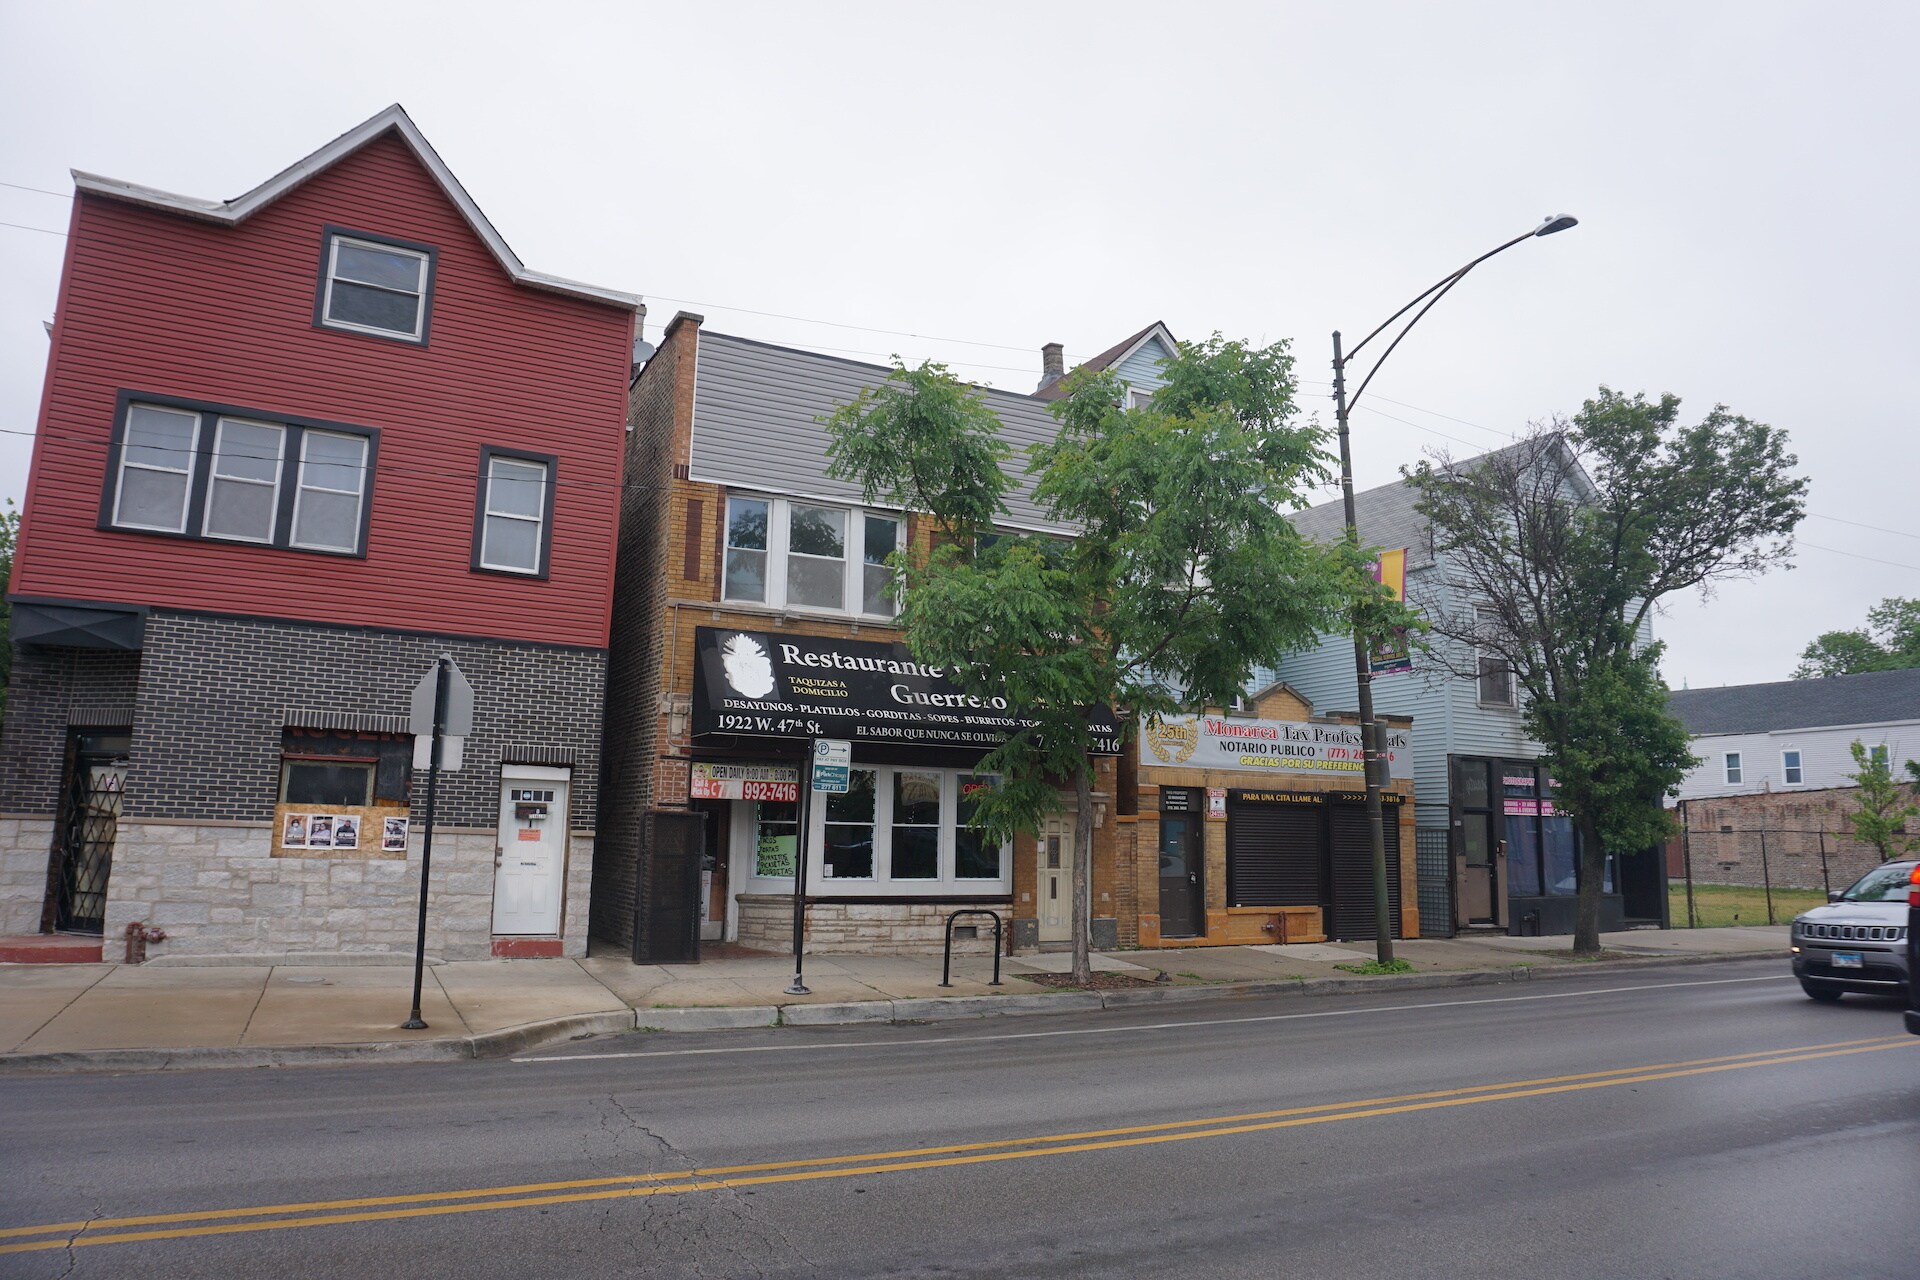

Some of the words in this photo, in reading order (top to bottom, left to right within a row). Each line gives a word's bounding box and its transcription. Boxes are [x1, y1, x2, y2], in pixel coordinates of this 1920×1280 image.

[779, 643, 943, 678] Restaurante
[788, 676, 838, 688] TAQUIZAS
[840, 680, 847, 688] A
[792, 686, 849, 698] DOMICILIO
[723, 699, 793, 712] DESAYUNOS
[800, 704, 860, 717] PLATILLOS
[866, 709, 921, 721] GORDITAS
[927, 713, 959, 724] SOPES
[964, 715, 1015, 727] BURRITOS
[718, 714, 753, 730] 1922
[755, 717, 775, 732] W.
[806, 720, 824, 735] St.
[1158, 723, 1188, 740] 25th
[1204, 719, 1279, 741] Monarca
[1281, 724, 1310, 743] Tax
[856, 725, 869, 736] EL
[870, 726, 903, 738] SABOR
[903, 728, 925, 740] QUE
[926, 729, 960, 741] NUNCA
[960, 731, 973, 743] SE
[1219, 740, 1268, 755] NOTARIO
[1271, 744, 1316, 757] PUBLICO
[1327, 747, 1349, 761] (773)
[1239, 756, 1280, 768] GRACIAS
[1281, 757, 1301, 769] POR
[1303, 759, 1315, 770] SU
[1316, 760, 1365, 772] PREFERENC
[712, 766, 728, 779] OPEN
[729, 766, 745, 780] DAILY
[759, 768, 769, 782] AM
[788, 770, 798, 782] PM
[744, 782, 797, 801] 992-7416
[1242, 793, 1260, 801] PARA
[1261, 793, 1275, 802] UNA
[1276, 794, 1291, 802] CITA
[1292, 795, 1312, 803] LLAME
